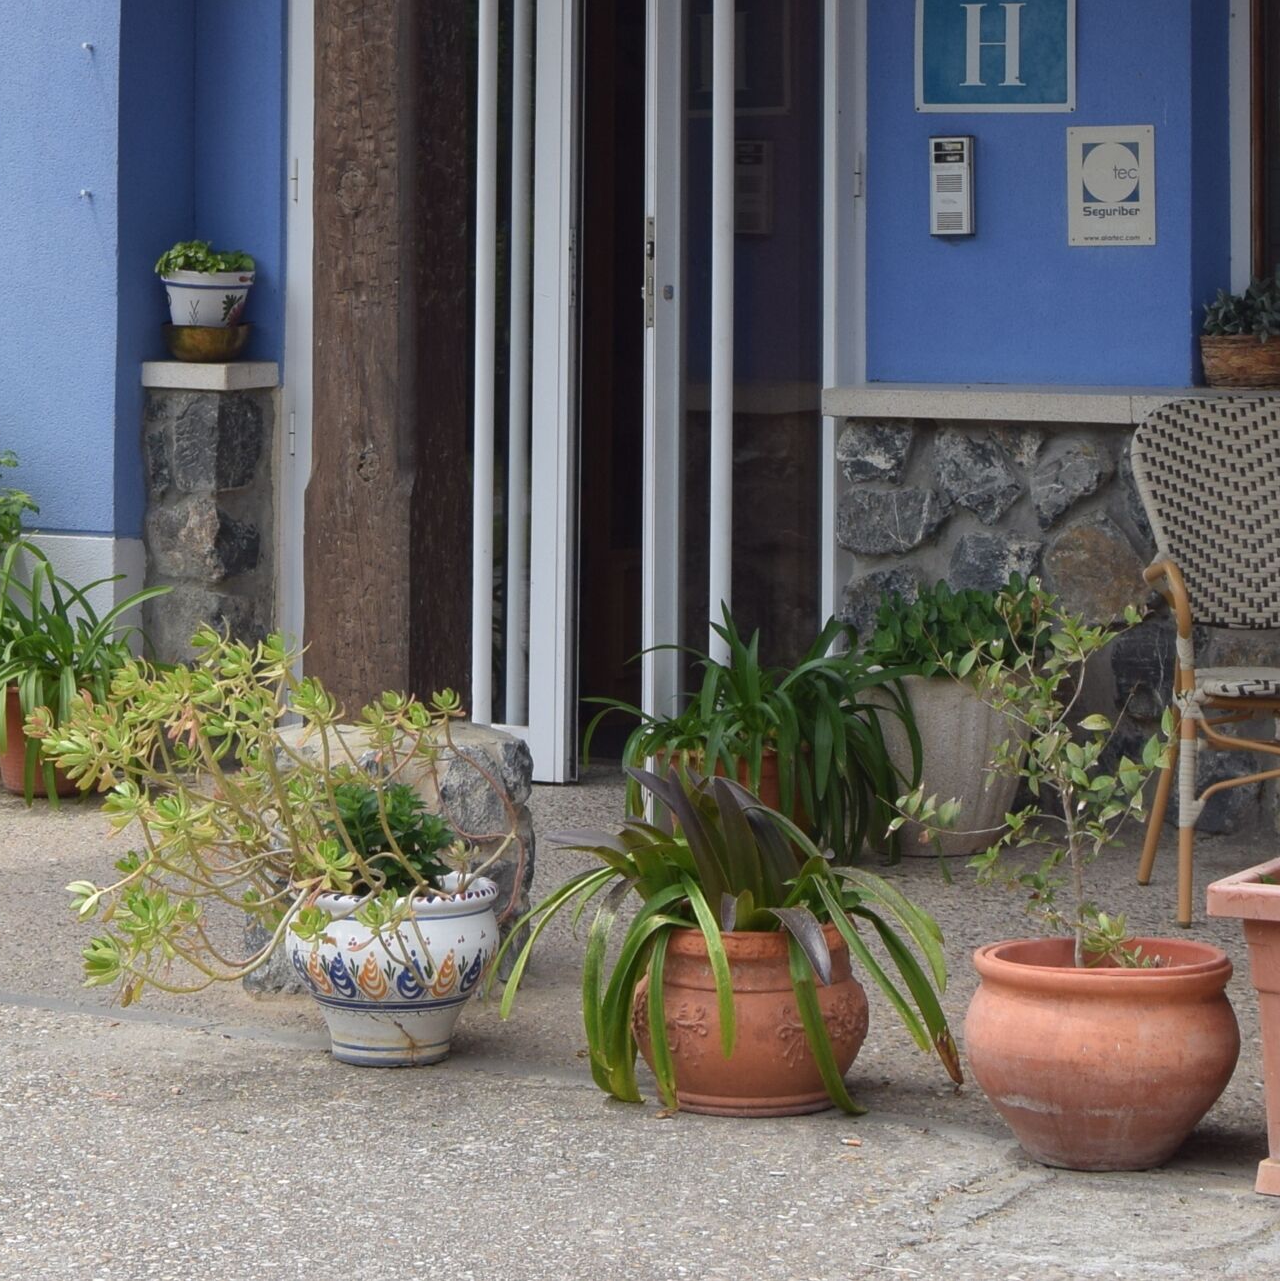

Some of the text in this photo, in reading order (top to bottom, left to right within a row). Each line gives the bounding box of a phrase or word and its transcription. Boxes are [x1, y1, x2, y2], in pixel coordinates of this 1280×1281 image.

[959, 2, 1027, 87] H
[1113, 164, 1138, 180] tec
[1082, 206, 1141, 219] Seguriber
